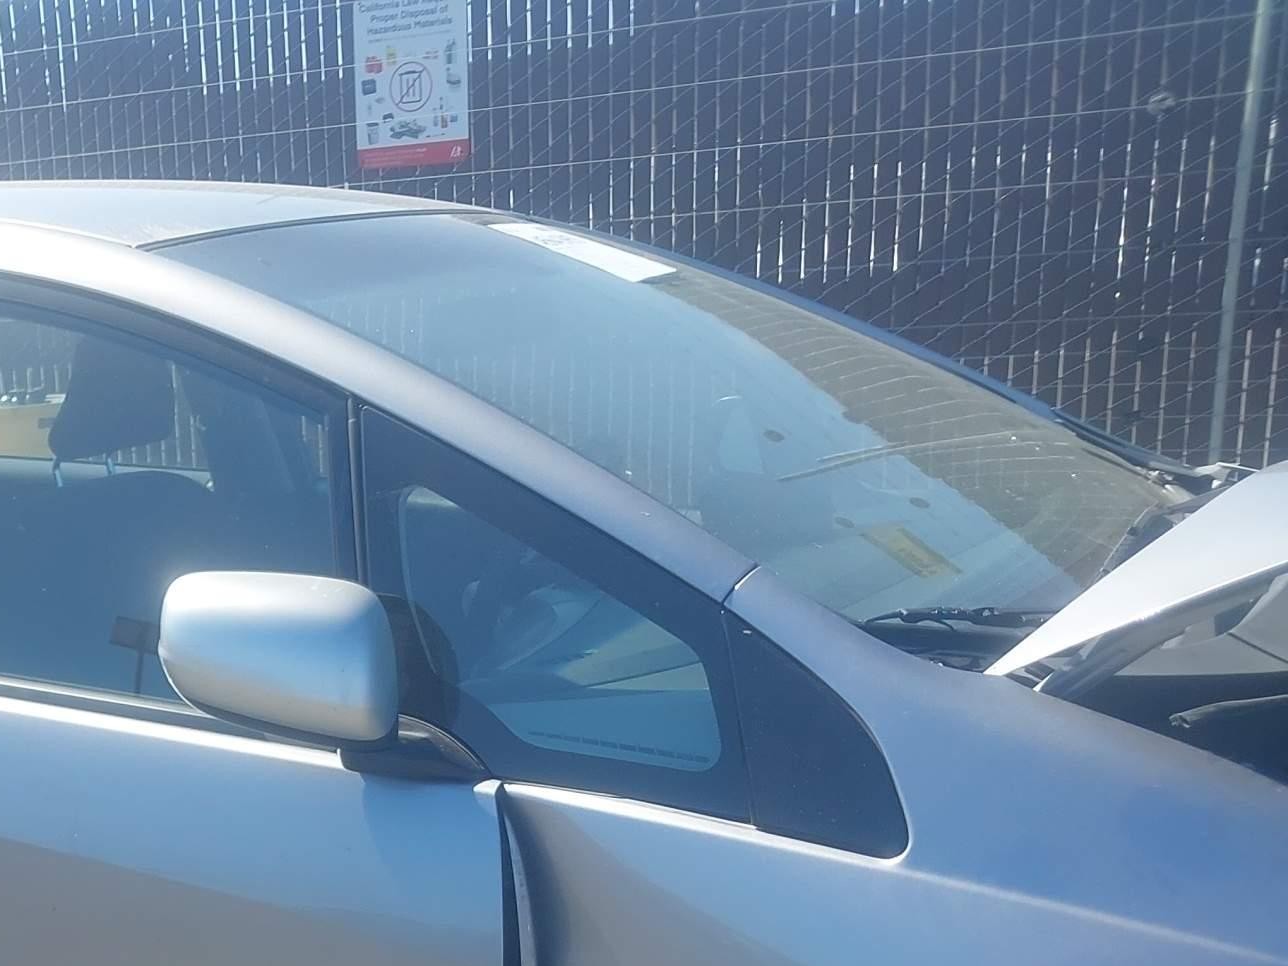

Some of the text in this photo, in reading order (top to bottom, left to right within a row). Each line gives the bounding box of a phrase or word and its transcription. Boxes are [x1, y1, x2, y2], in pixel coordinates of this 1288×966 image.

[370, 13, 399, 24] Proper
[400, 7, 437, 19] Disposal
[367, 17, 453, 35] Hazardous Materials
